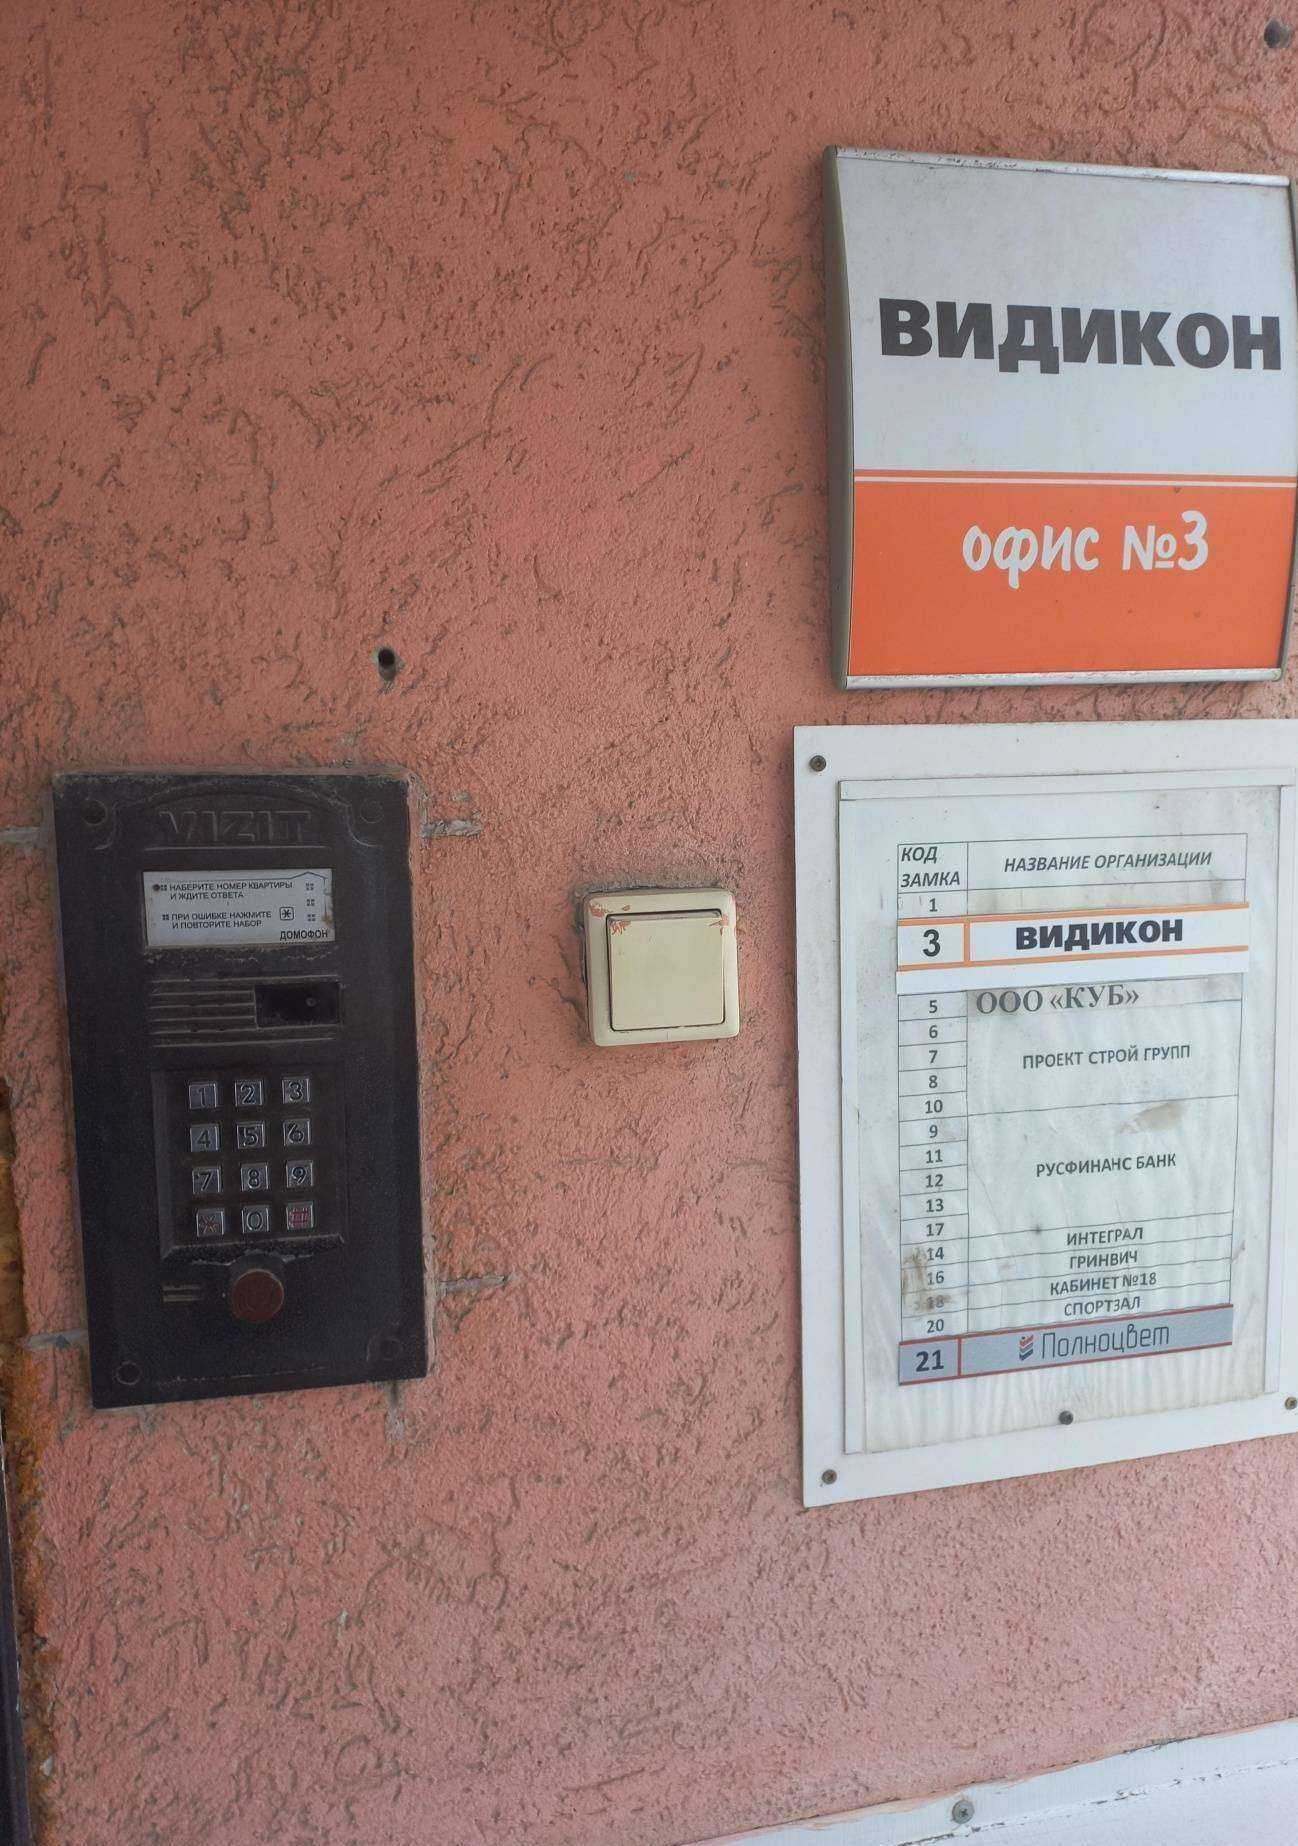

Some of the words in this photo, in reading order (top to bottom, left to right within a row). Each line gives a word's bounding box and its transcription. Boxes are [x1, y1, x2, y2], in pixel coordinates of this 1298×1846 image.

[879, 297, 1281, 374] ВИДИКОН
[1122, 510, 1209, 571] №3
[158, 810, 311, 843] VIZIT
[900, 846, 938, 864] КОД
[1004, 854, 1090, 873] НАЗВАНИЕ
[1095, 851, 1212, 870] ОРГАНИЗАЦИИ
[169, 882, 214, 891] НАБЕРИТЕ
[217, 882, 247, 890] НОМЕР
[248, 881, 293, 889] КВАРТИРЫ
[900, 871, 961, 888] ЗАМКА
[178, 892, 209, 900] ЖДИТЕ
[928, 898, 939, 912] 1
[191, 913, 227, 921] ОШИБКЕ
[229, 911, 272, 919] НАЖМИТЕ
[180, 921, 231, 929] ПОВТОРИТЕ
[280, 930, 328, 941] ДОМОФОН
[922, 928, 941, 957] 3
[1015, 918, 1184, 952] ВИДИКОН
[928, 1000, 938, 1014] 5
[976, 989, 1043, 1016] ООО
[1050, 984, 1140, 1010] «КУБ»
[928, 1024, 938, 1039] 6
[928, 1049, 938, 1064] 7
[1022, 1051, 1082, 1070] ПРОЕКТ
[1088, 1045, 1138, 1066] СТРОЙ
[1144, 1045, 1191, 1062] ГРУПП
[928, 1074, 938, 1089] 8
[241, 1083, 255, 1104] 2
[288, 1081, 303, 1102] 3
[924, 1099, 943, 1114] 10
[928, 1125, 938, 1139] 9
[925, 1149, 943, 1164] 11
[1035, 1156, 1132, 1177] РУСФИНАНС
[1135, 1153, 1177, 1170] БАНК
[925, 1174, 944, 1188] 12
[925, 1198, 944, 1213] 13
[926, 1223, 944, 1237] 17
[1066, 1227, 1144, 1246] ИНТЕГРАЛ
[926, 1246, 945, 1261] 14
[1069, 1250, 1138, 1269] ГРИНВИЧ
[927, 1271, 945, 1286] 16
[1050, 1275, 1119, 1296] КАБИНЕТ
[1122, 1272, 1157, 1288] №18
[1064, 1296, 1141, 1317] СПОРТЗАЛ
[926, 1318, 945, 1333] 20
[1041, 1323, 1170, 1360] Полноцвет
[915, 1349, 945, 1372] 21
